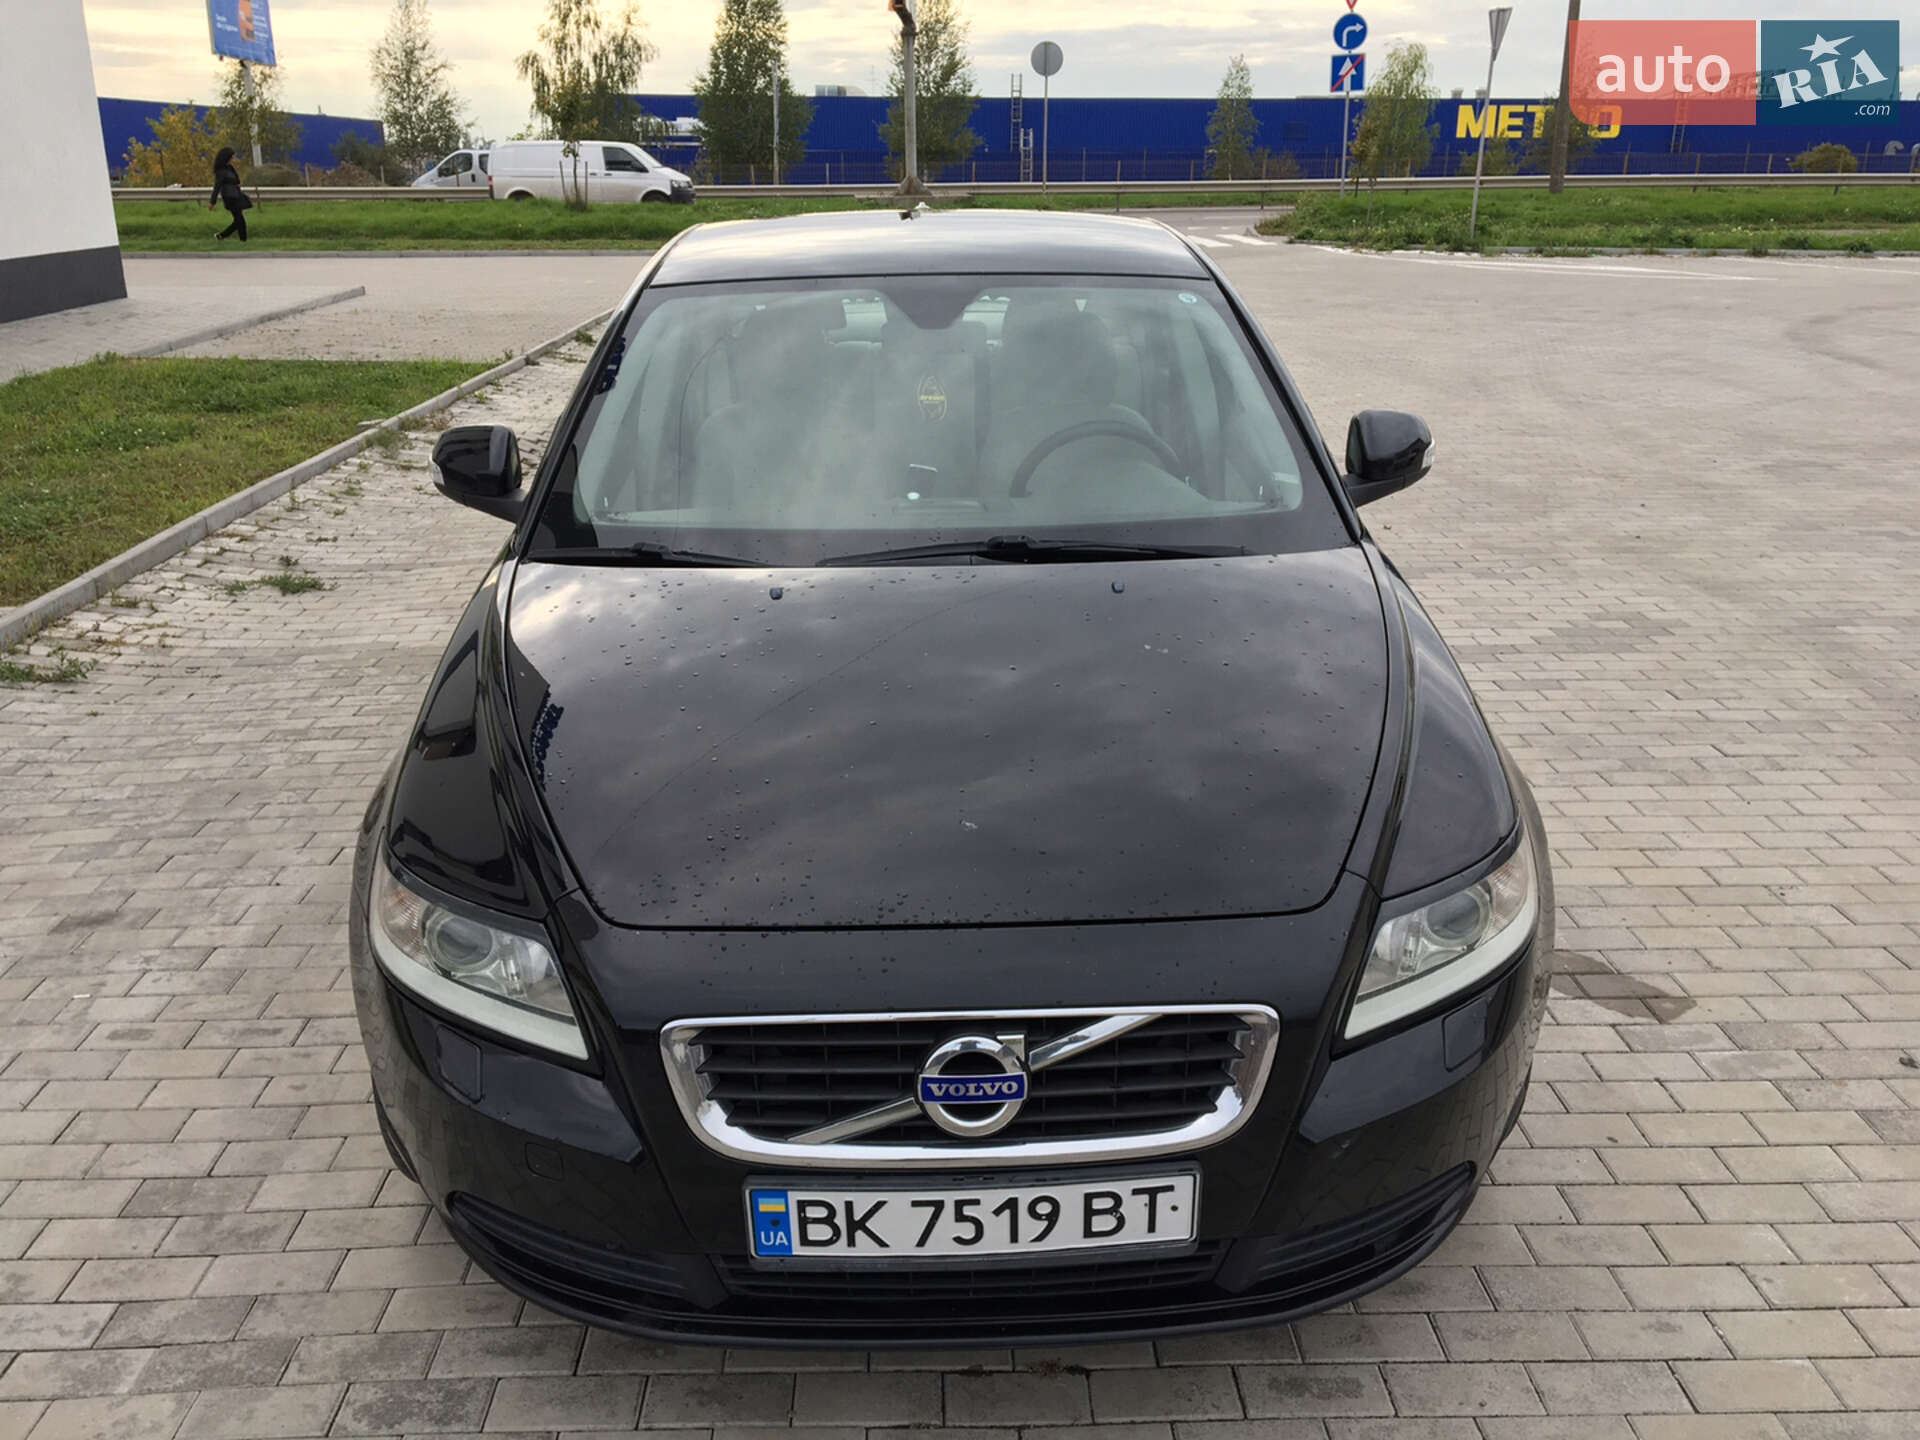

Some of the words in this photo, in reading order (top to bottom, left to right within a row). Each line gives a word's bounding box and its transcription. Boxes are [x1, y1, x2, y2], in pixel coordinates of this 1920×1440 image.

[1456, 104, 1623, 139] METO
[927, 1081, 1019, 1097] VOLVO
[797, 1199, 891, 1248] BK
[910, 1195, 1061, 1247] 7519
[1083, 1184, 1176, 1239] BT
[760, 1230, 789, 1247] UA
